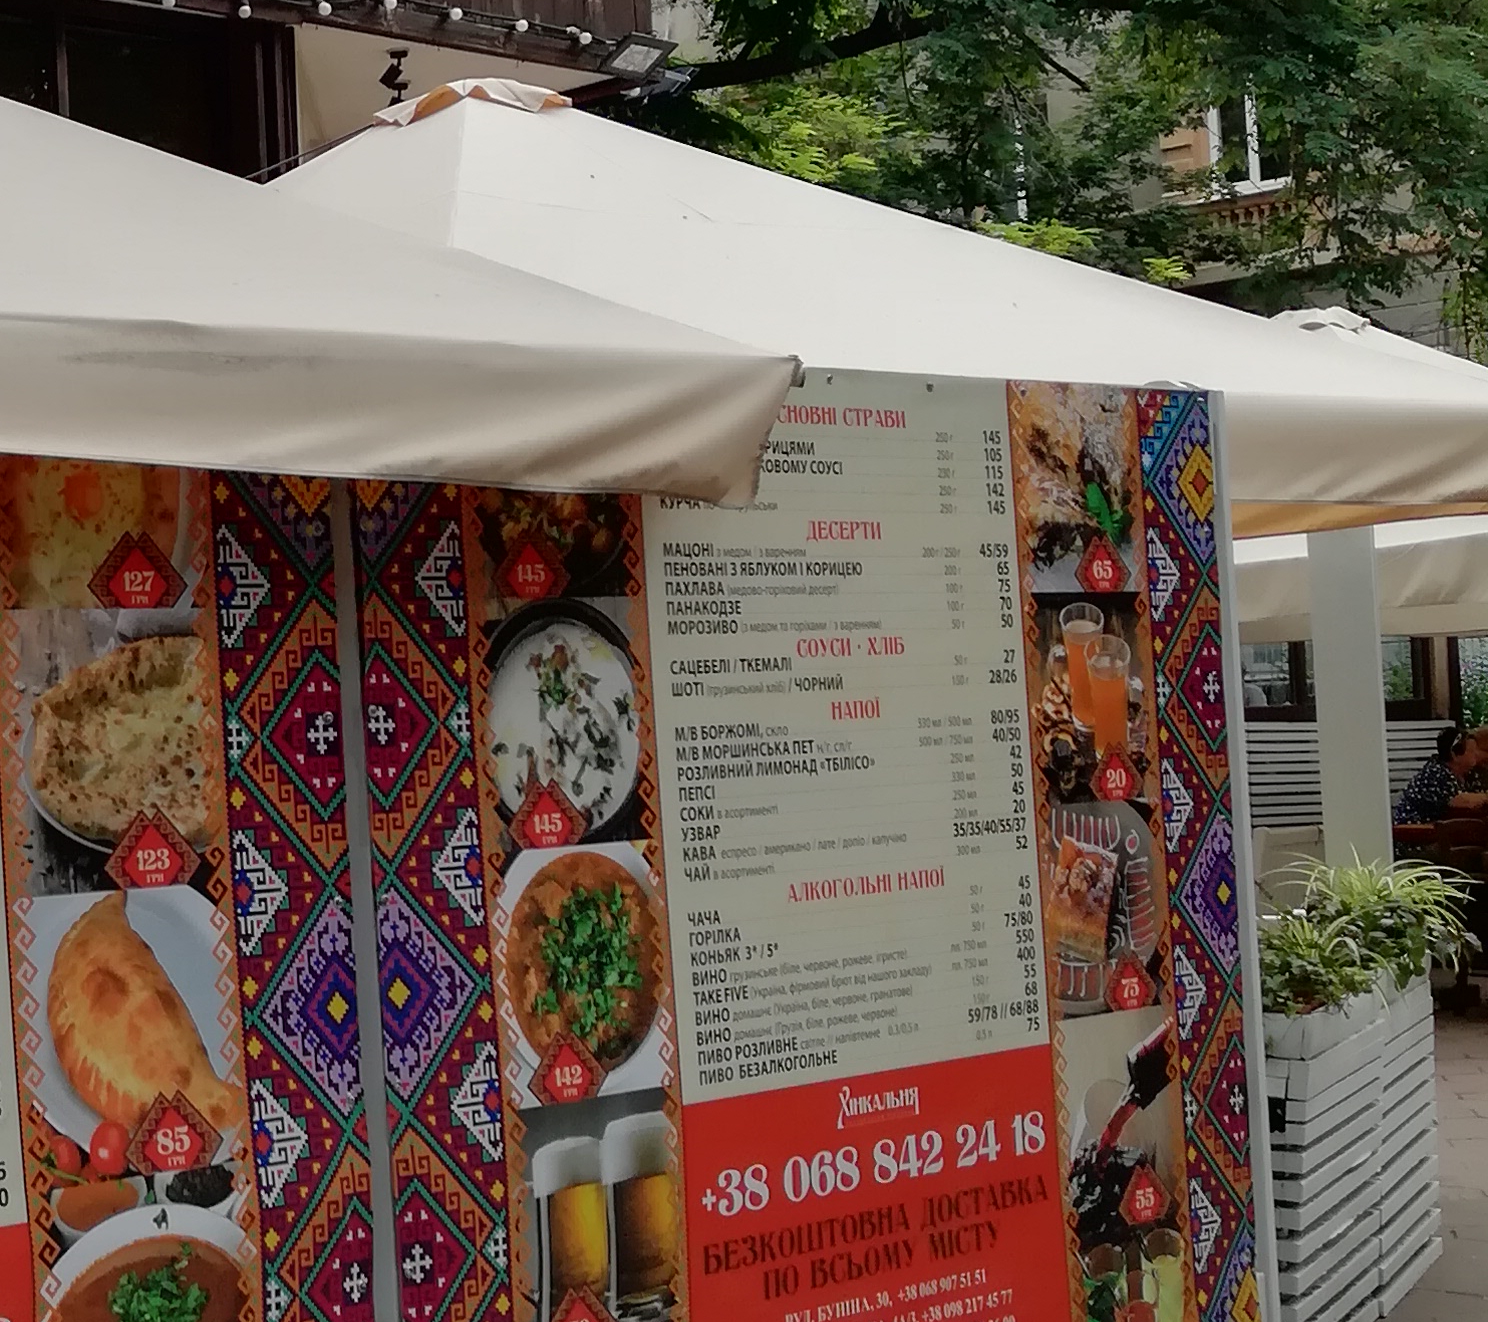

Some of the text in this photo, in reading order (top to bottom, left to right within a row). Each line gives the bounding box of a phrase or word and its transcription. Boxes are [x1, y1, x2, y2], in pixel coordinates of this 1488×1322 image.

[806, 520, 880, 541] ДЕСЕРТИ
[664, 561, 1009, 579] ПЕНОВАНІ З ЯБЛУКОМ І КОРИЦЕЮ 65
[124, 571, 154, 591] 127
[665, 579, 1010, 595] ПАХЛАВА 75
[666, 596, 1012, 618] ПАНАКОДЗЕ 70
[668, 614, 1013, 635] МОРОЗИВО 50
[795, 636, 904, 657] СОУСИ ХЛІБ
[830, 698, 880, 721] НАПОЇ
[679, 785, 715, 801] ПЕПСІ
[137, 848, 170, 870] 123
[788, 869, 944, 902] АЛКОГОЛЬНІ НАПОЇ
[838, 1086, 919, 1129] ХІНКАЛЬНЯ
[157, 1125, 190, 1155] 85
[702, 1111, 1045, 1216] +38 068 842 24 18
